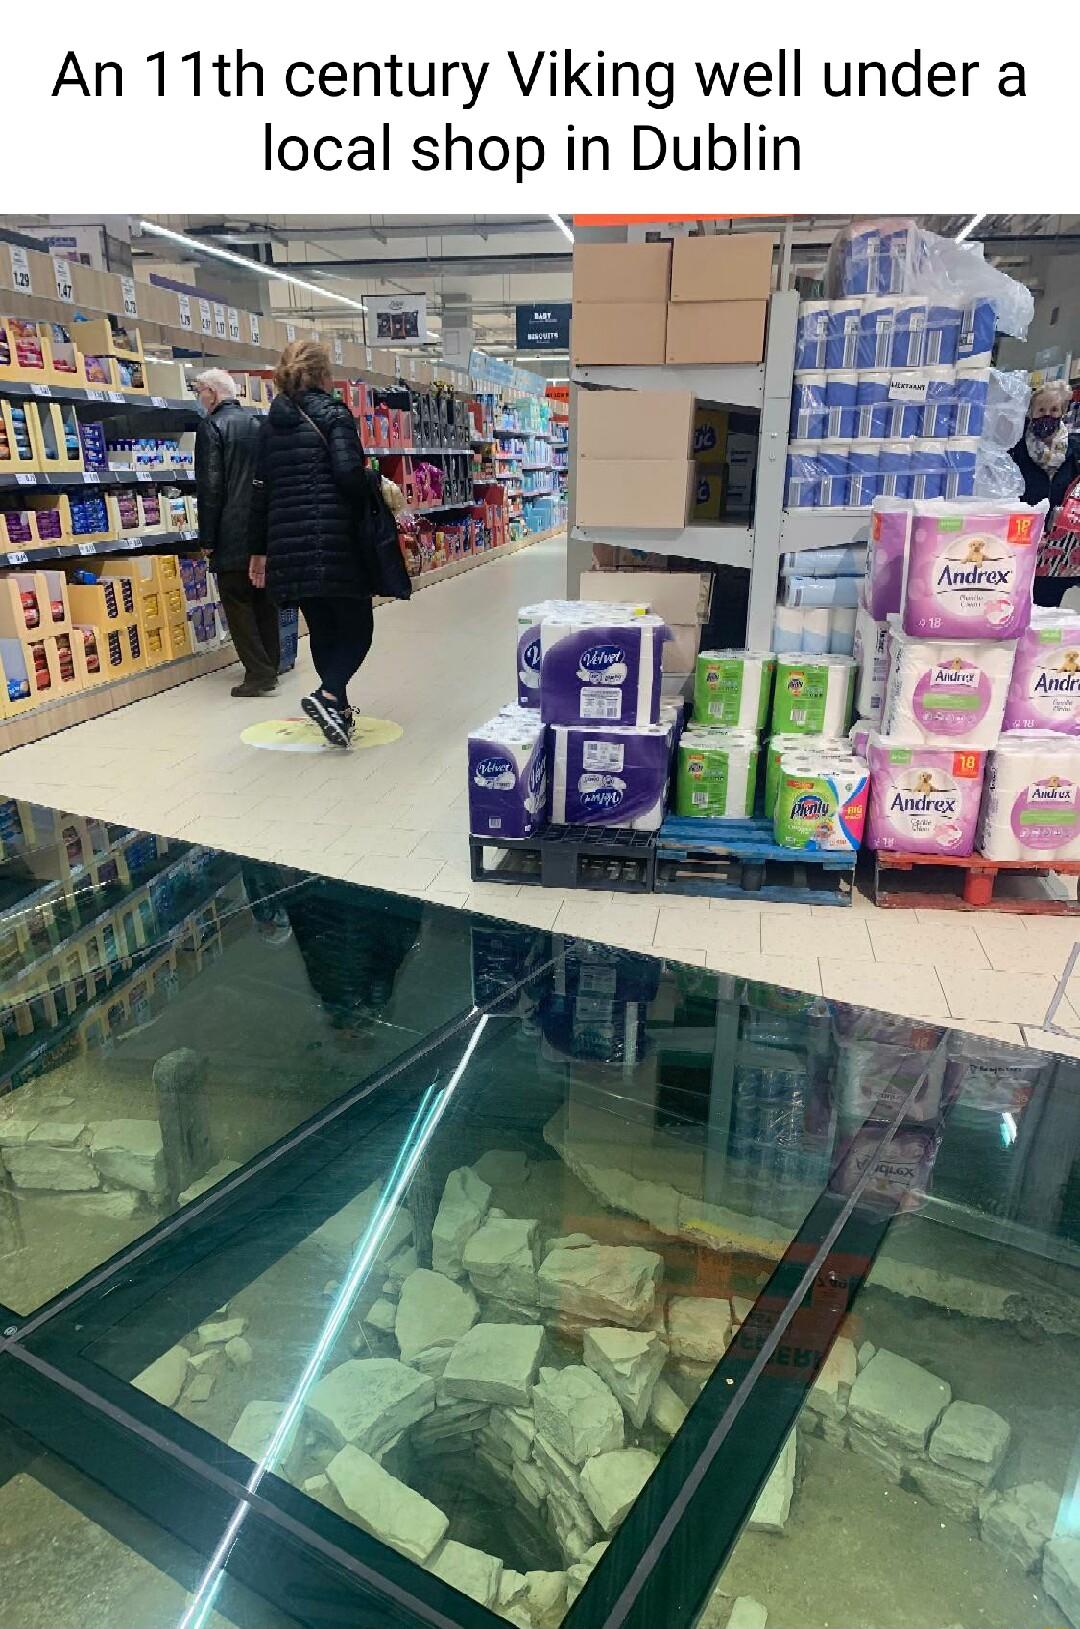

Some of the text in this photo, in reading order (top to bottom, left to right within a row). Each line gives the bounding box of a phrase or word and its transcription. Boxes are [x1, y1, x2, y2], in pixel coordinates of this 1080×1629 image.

[14, 272, 29, 287] 1.29
[58, 282, 72, 299] 1.47
[534, 312, 551, 320] BABY
[937, 564, 1012, 586] Andrex
[928, 617, 942, 628] 18
[583, 650, 621, 667] Velvet
[935, 669, 975, 683] Andrex
[479, 761, 511, 775] Velvet
[961, 755, 976, 769] 18
[1031, 788, 1071, 800] Andrex
[890, 792, 956, 813] Andrex
[790, 800, 830, 820] Plenty
